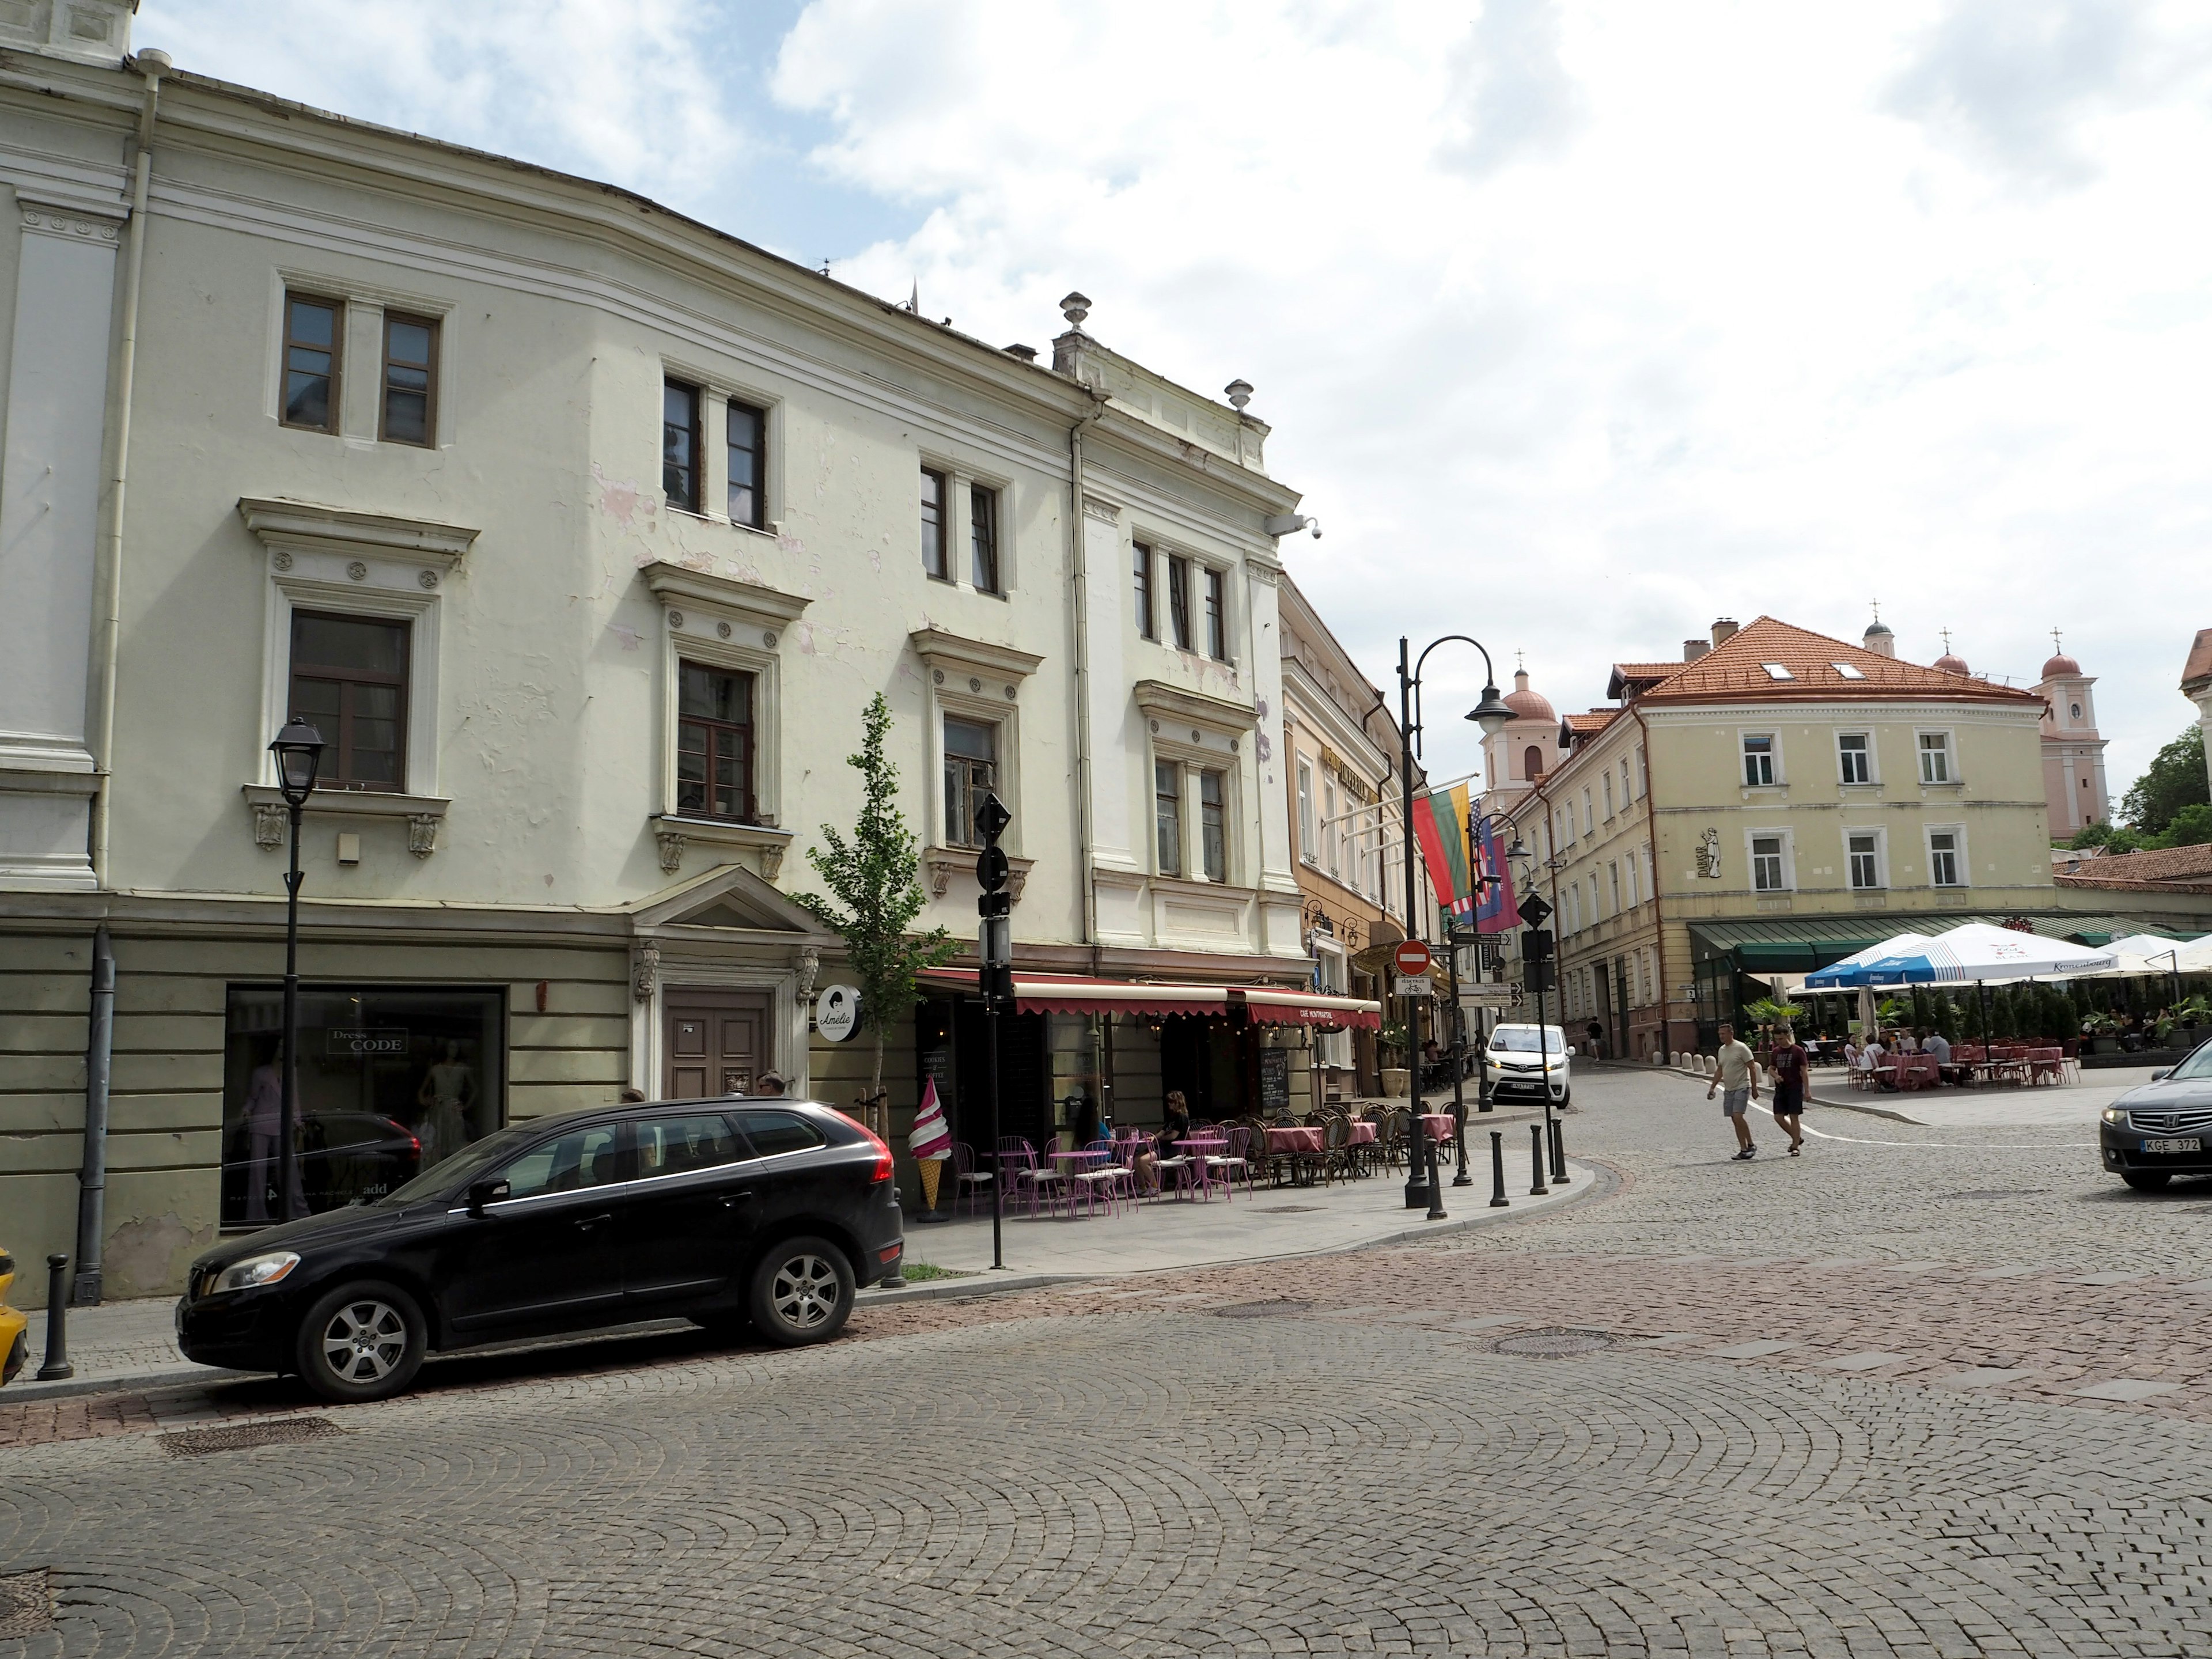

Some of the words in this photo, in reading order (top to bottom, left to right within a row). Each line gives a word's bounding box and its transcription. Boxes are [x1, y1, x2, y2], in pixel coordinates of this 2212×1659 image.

[1695, 845, 1709, 877] IDABASAR
[2053, 959, 2111, 972] Kronenbourg
[820, 1012, 851, 1025] Amélie
[333, 1031, 367, 1039] Dress
[350, 1039, 403, 1051] CODE
[2146, 1141, 2171, 1151] KGE
[2177, 1139, 2199, 1150] 372
[363, 1183, 388, 1195] add
